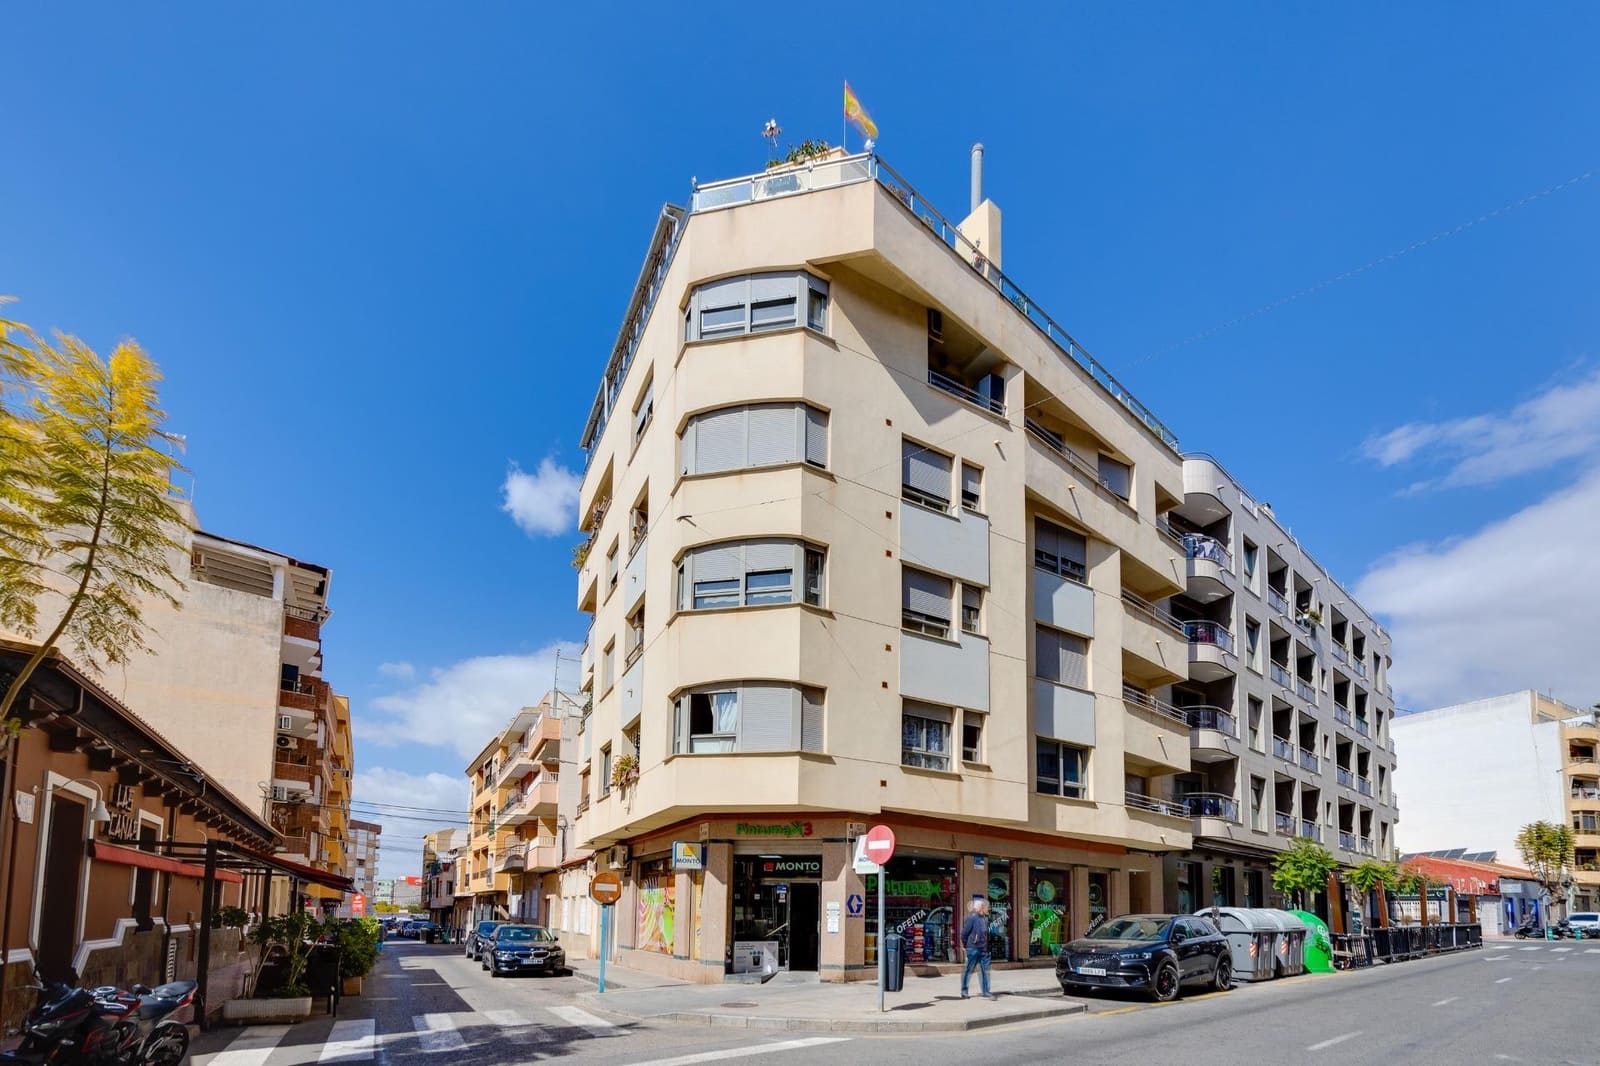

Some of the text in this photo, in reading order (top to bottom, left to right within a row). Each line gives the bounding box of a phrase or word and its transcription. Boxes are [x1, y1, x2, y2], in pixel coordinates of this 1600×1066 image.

[116, 784, 135, 810] LAS
[804, 821, 813, 836] 3
[775, 862, 820, 871] MONTO
[896, 909, 927, 934] OFERTA
